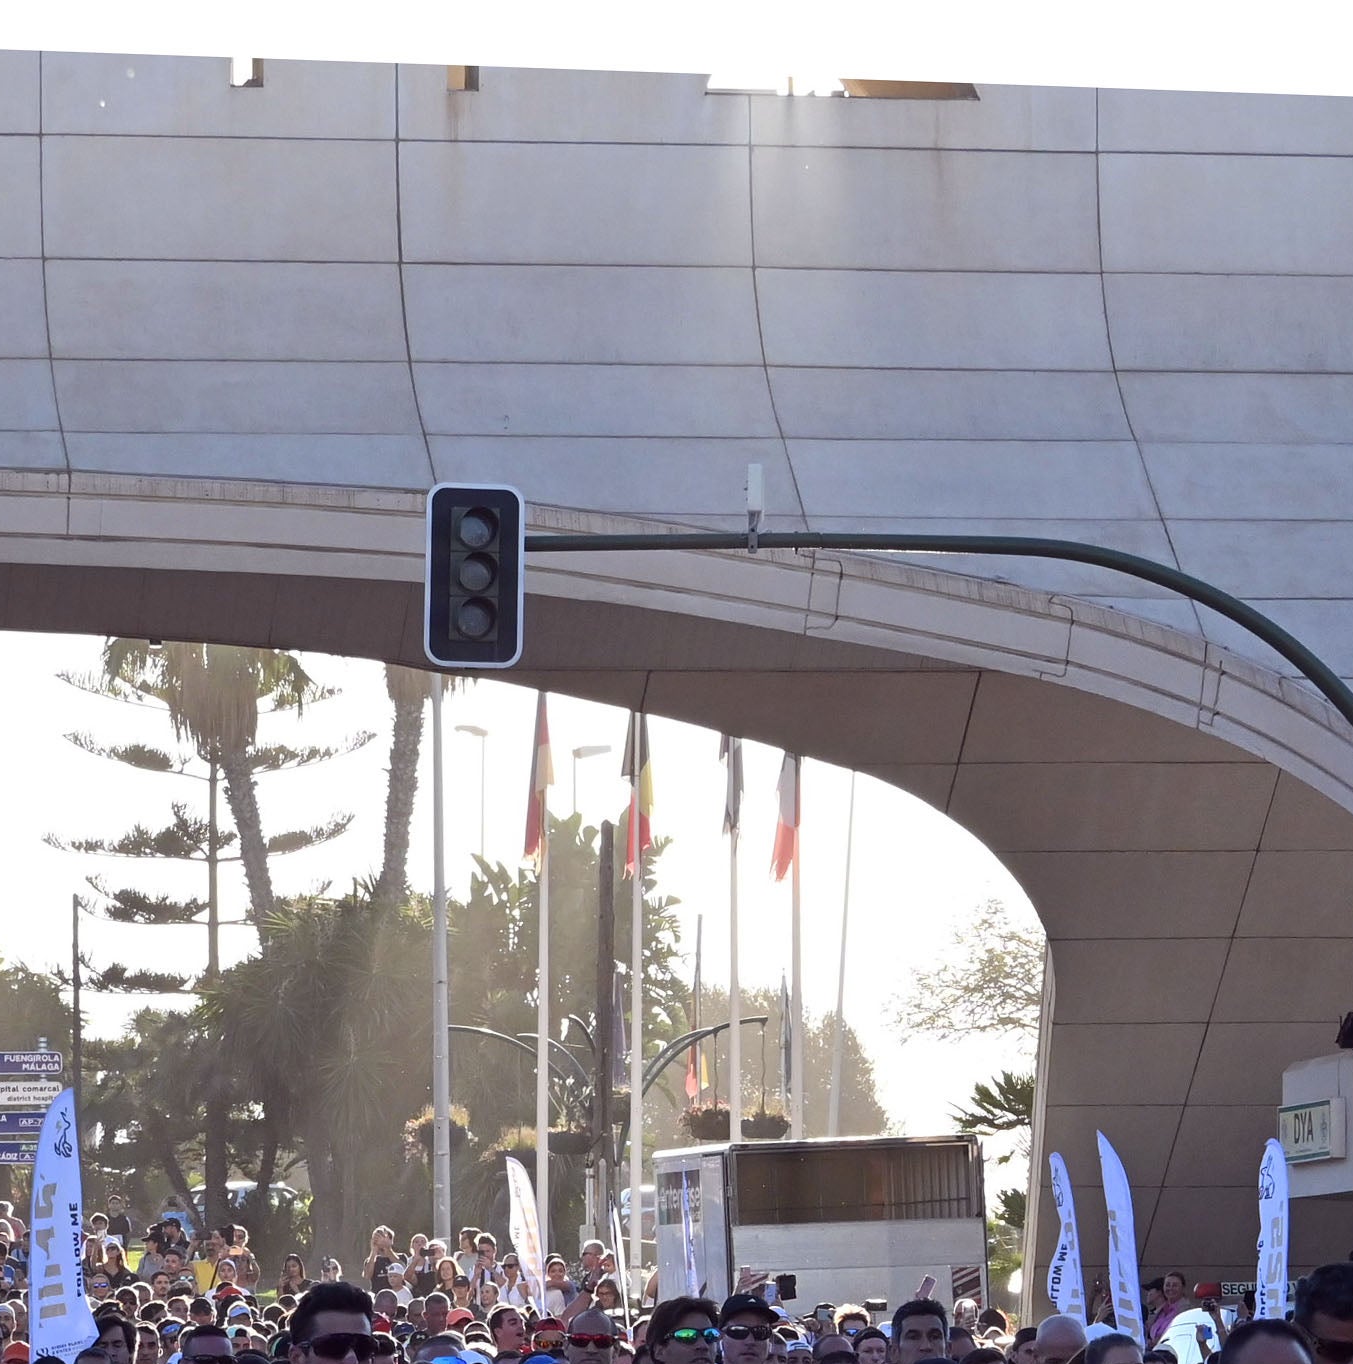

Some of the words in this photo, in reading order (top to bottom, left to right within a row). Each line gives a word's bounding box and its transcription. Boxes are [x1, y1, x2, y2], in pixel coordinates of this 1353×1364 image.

[4, 1054, 60, 1063] FUENGIROLA
[22, 1062, 60, 1071] MÁLAGA
[22, 1084, 60, 1093] comarcal
[1293, 1111, 1315, 1145] DYA
[69, 1202, 79, 1227] ME
